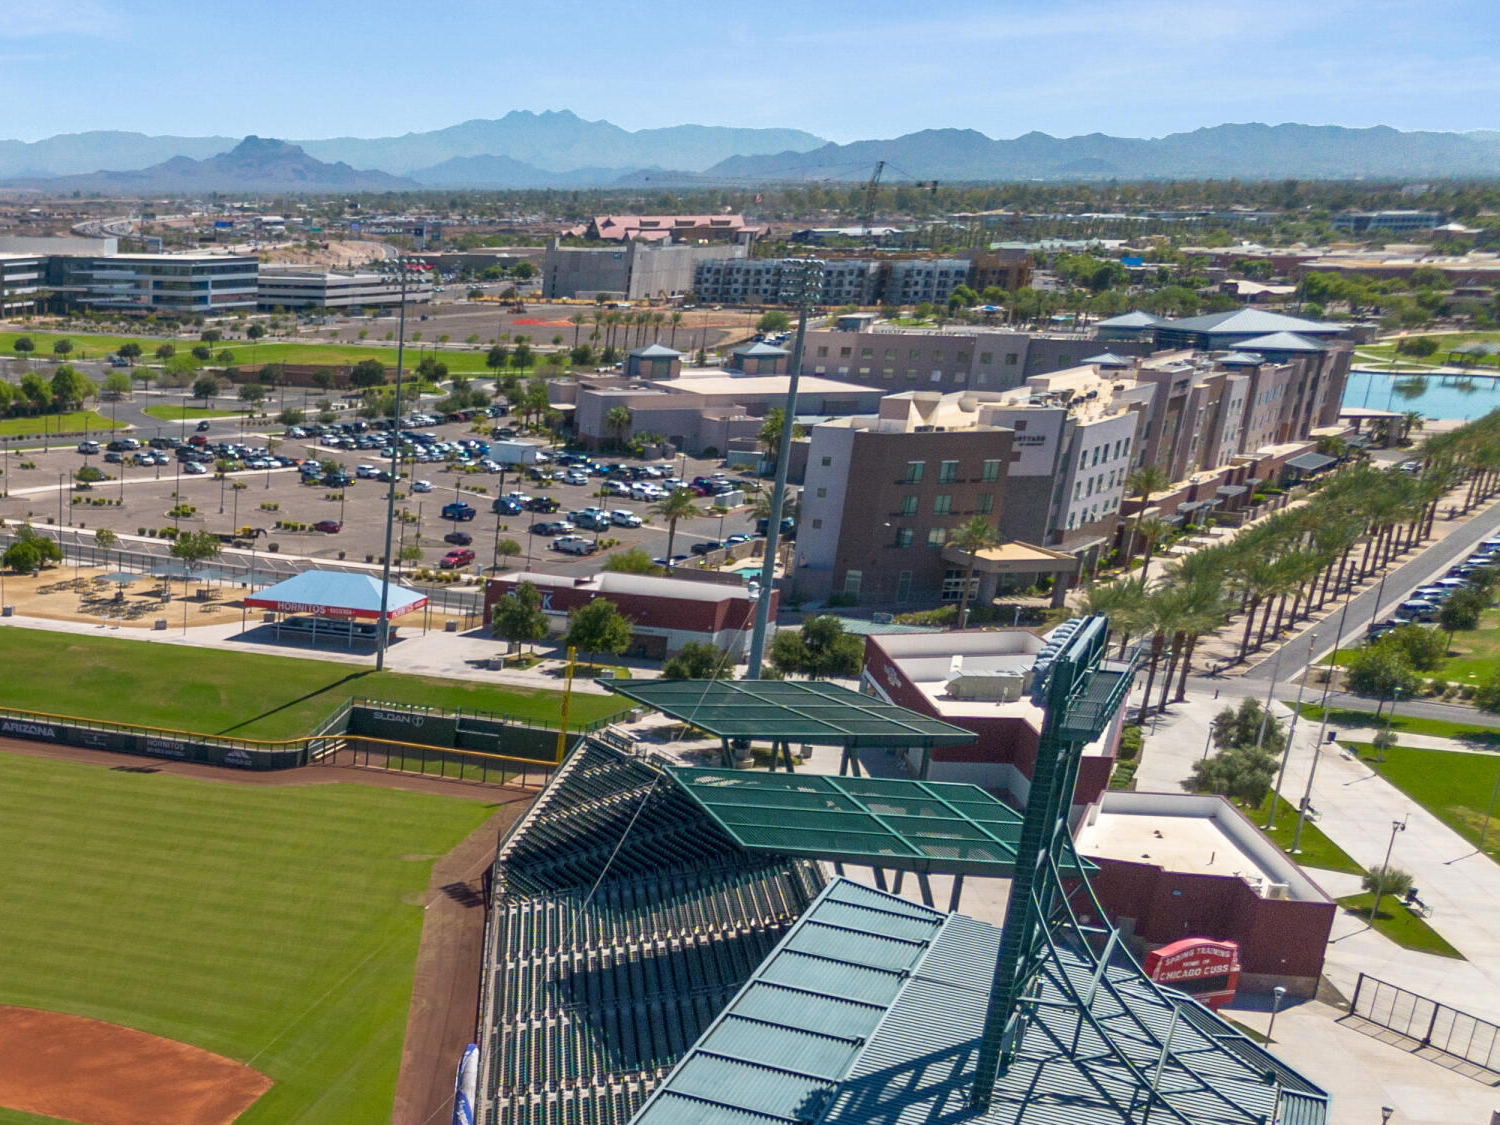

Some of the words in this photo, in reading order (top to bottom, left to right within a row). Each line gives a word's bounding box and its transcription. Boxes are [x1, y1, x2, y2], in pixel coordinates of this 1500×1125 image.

[277, 601, 326, 615] HORNITOS
[372, 710, 411, 724] SLOAN
[2, 721, 56, 738] ARIZONA
[1164, 949, 1194, 966] SPRING
[1196, 947, 1231, 958] TRAINING
[1160, 968, 1202, 981] CHICAGO
[1203, 964, 1229, 975] CUBS
